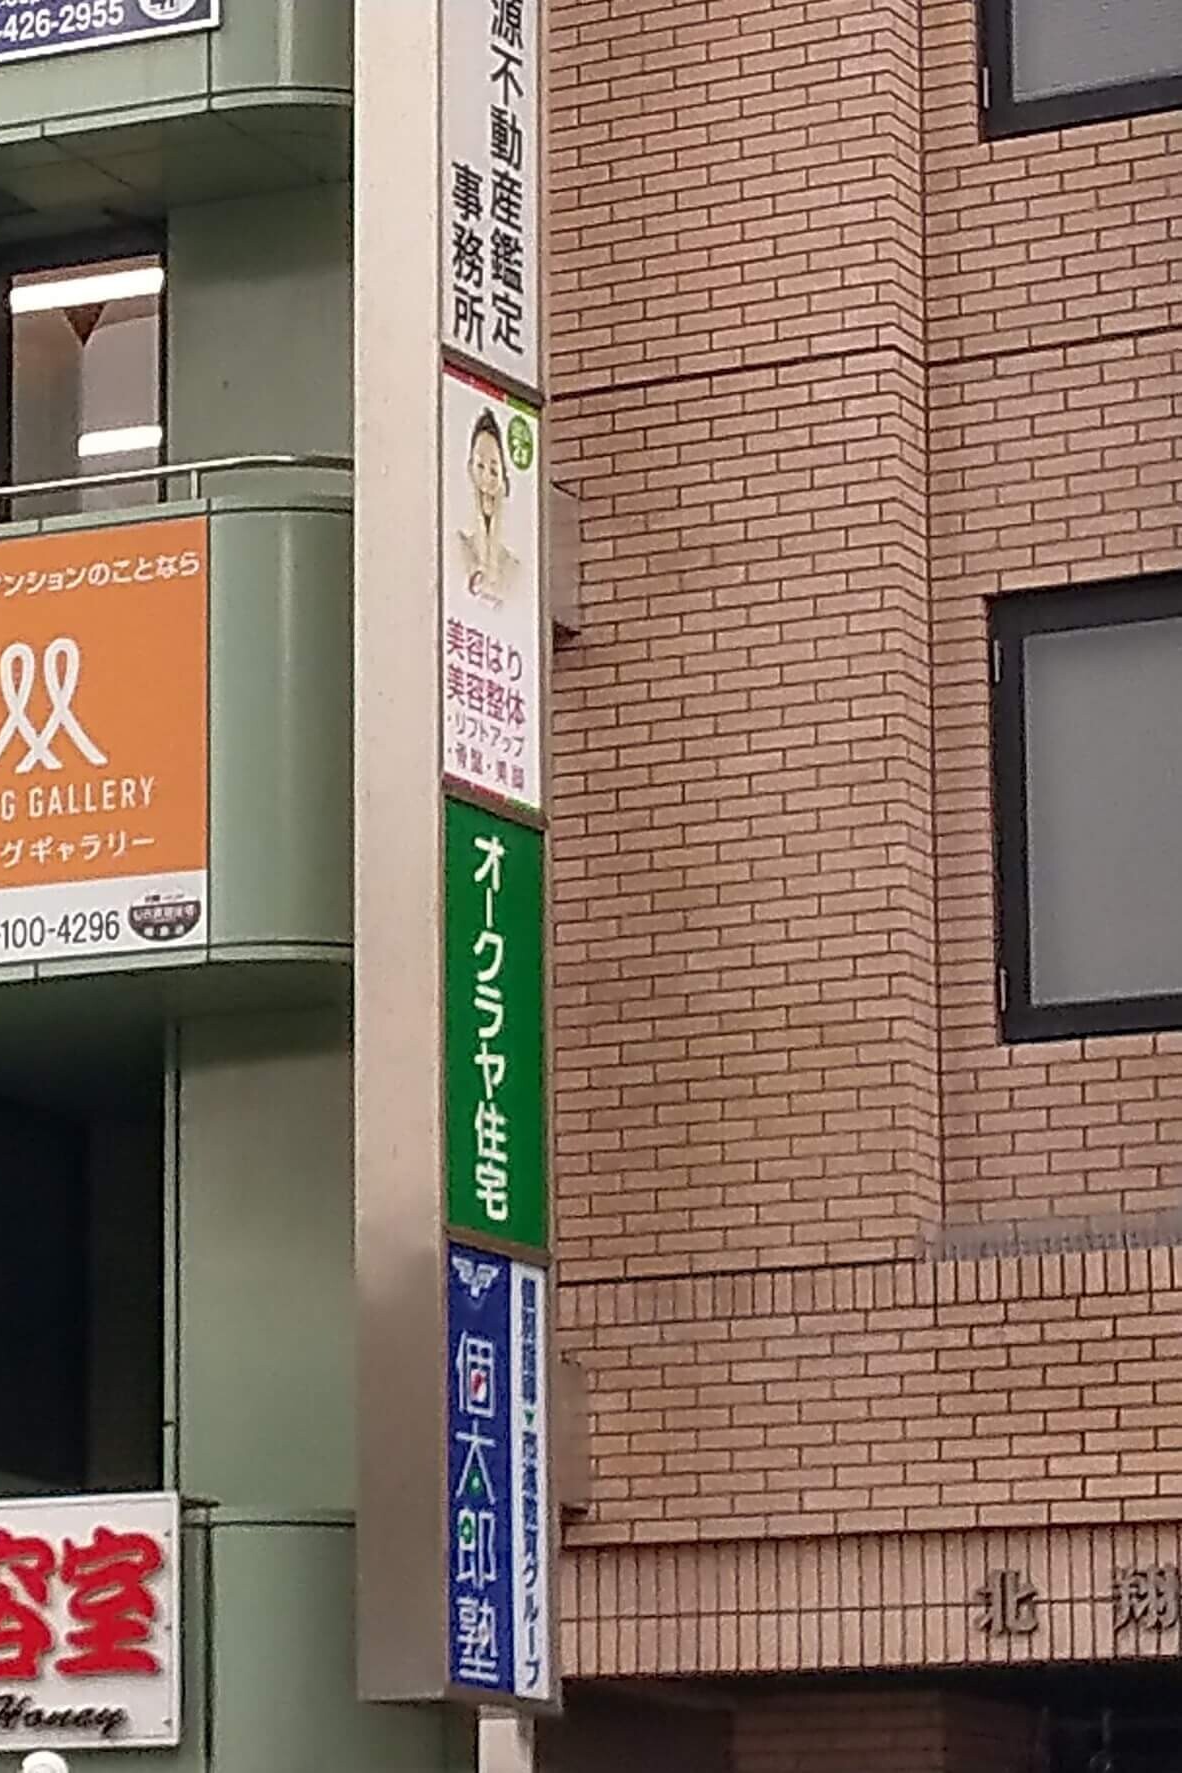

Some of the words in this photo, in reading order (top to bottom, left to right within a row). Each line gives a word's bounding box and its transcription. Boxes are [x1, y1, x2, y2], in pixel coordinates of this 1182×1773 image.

[451, 160, 485, 352] 事務所
[447, 616, 523, 681] 美容はり
[28, 775, 155, 819] GALLERY
[473, 836, 509, 1222] オークラヤ住宅
